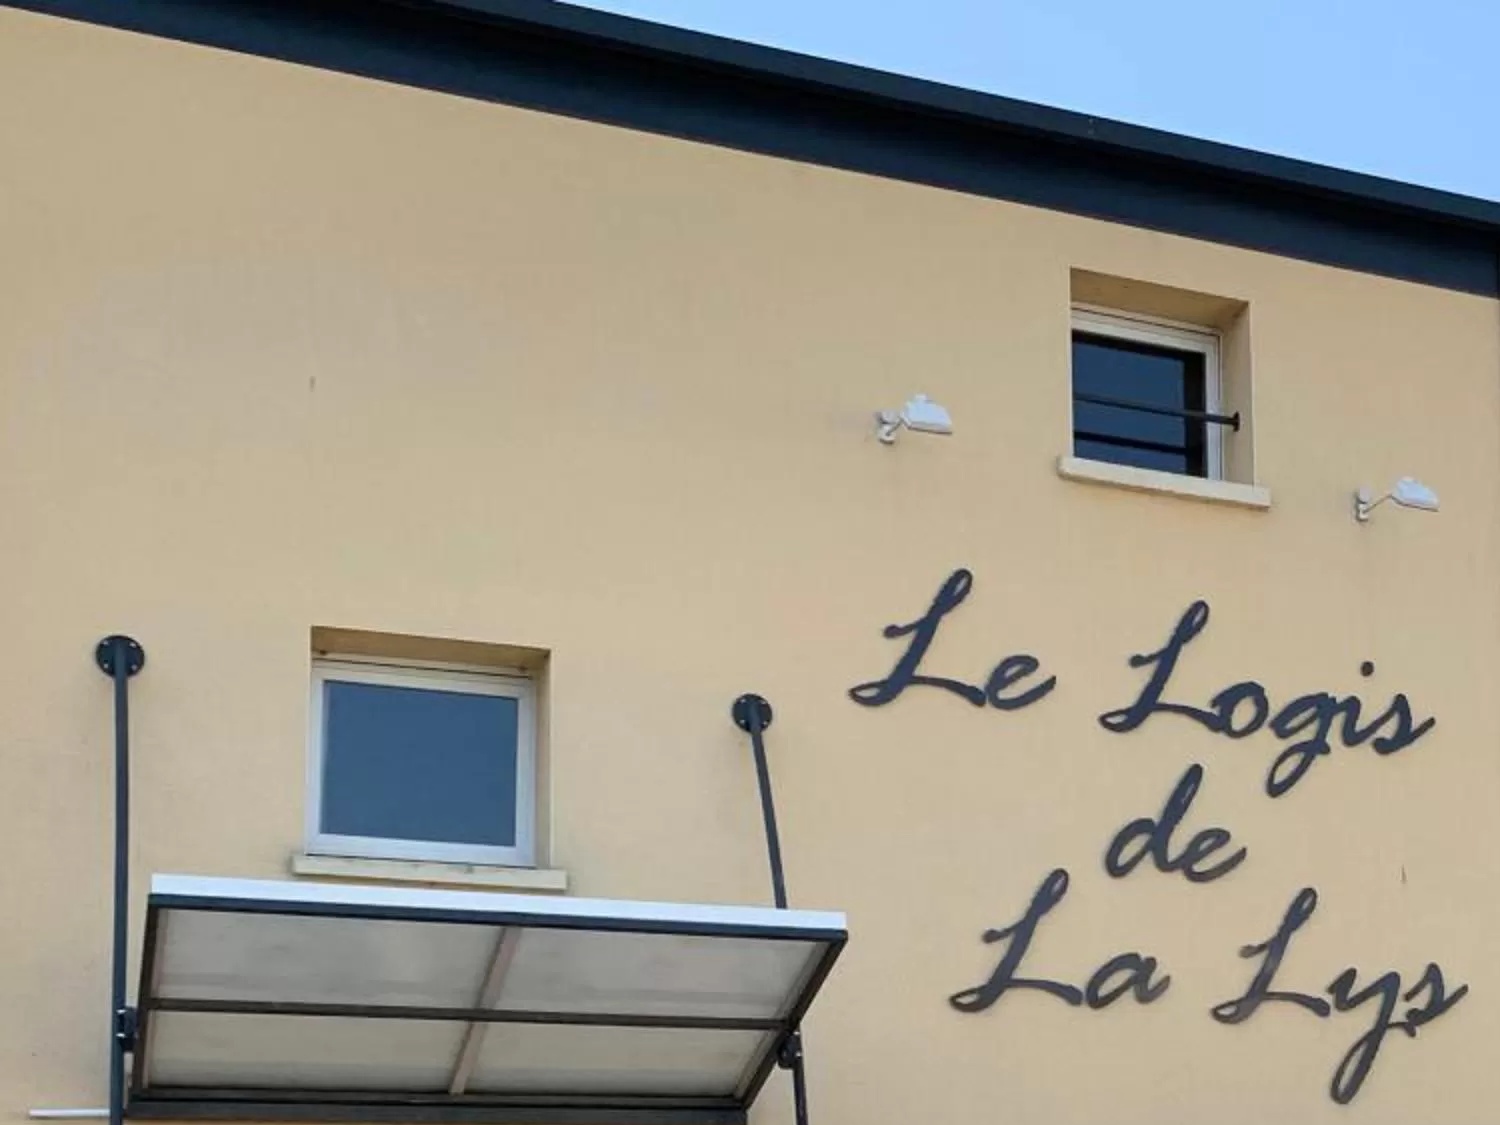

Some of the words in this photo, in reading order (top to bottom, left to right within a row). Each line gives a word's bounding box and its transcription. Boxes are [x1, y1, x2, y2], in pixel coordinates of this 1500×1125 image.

[848, 568, 1057, 711] Le
[1098, 600, 1436, 798] Logis
[1104, 763, 1247, 883] de
[948, 867, 1171, 1013] La
[1211, 887, 1469, 1104] Lys
